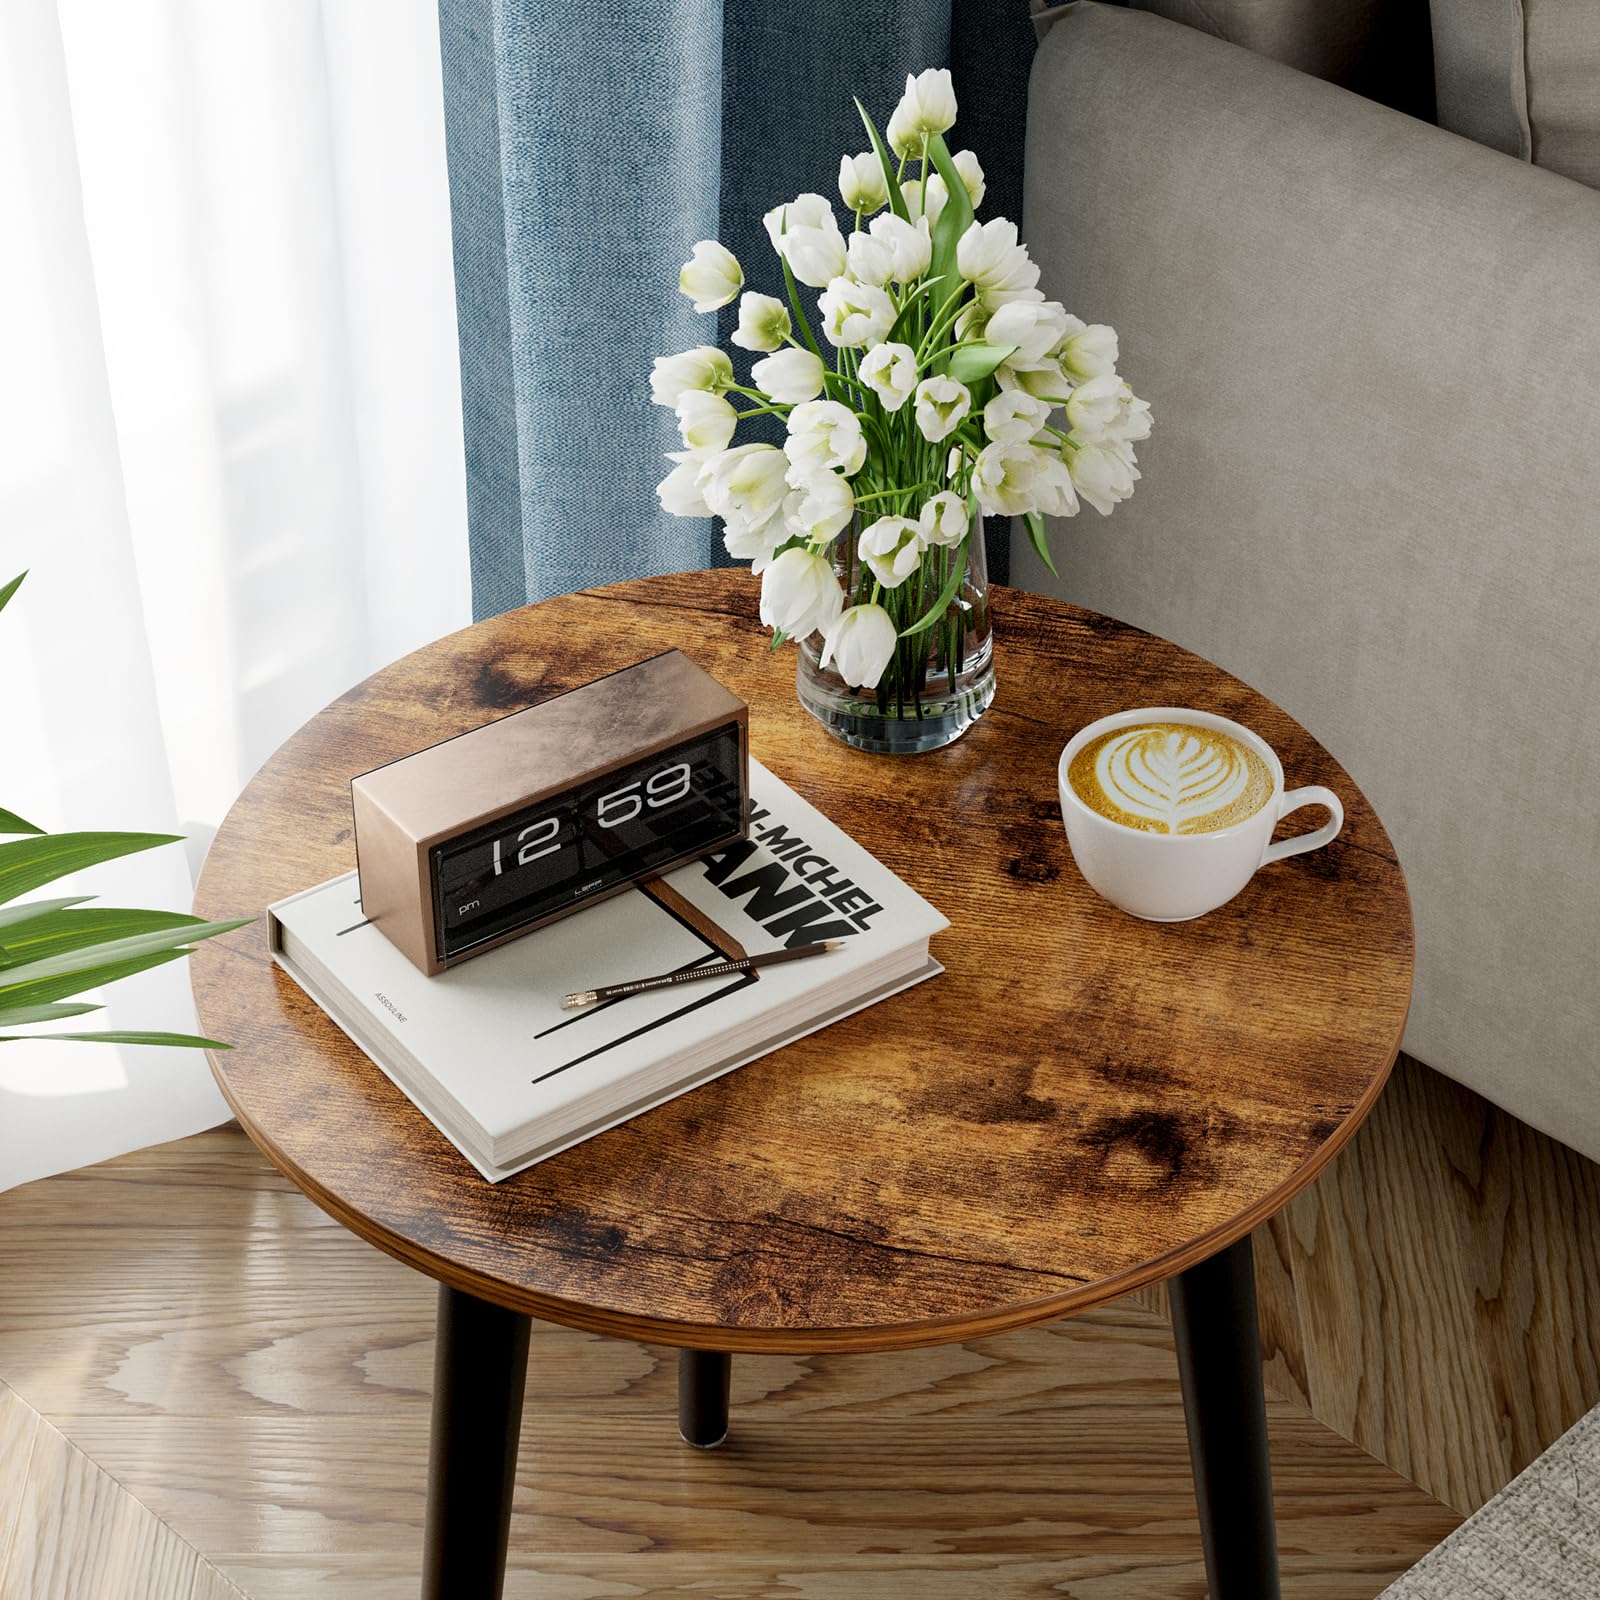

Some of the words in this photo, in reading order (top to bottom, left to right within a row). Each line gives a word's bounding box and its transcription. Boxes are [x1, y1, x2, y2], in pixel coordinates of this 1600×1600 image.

[492, 817, 562, 876] 12
[597, 763, 691, 829] 59
[458, 900, 480, 916] pm
[374, 992, 408, 1024] ASSOULINE
